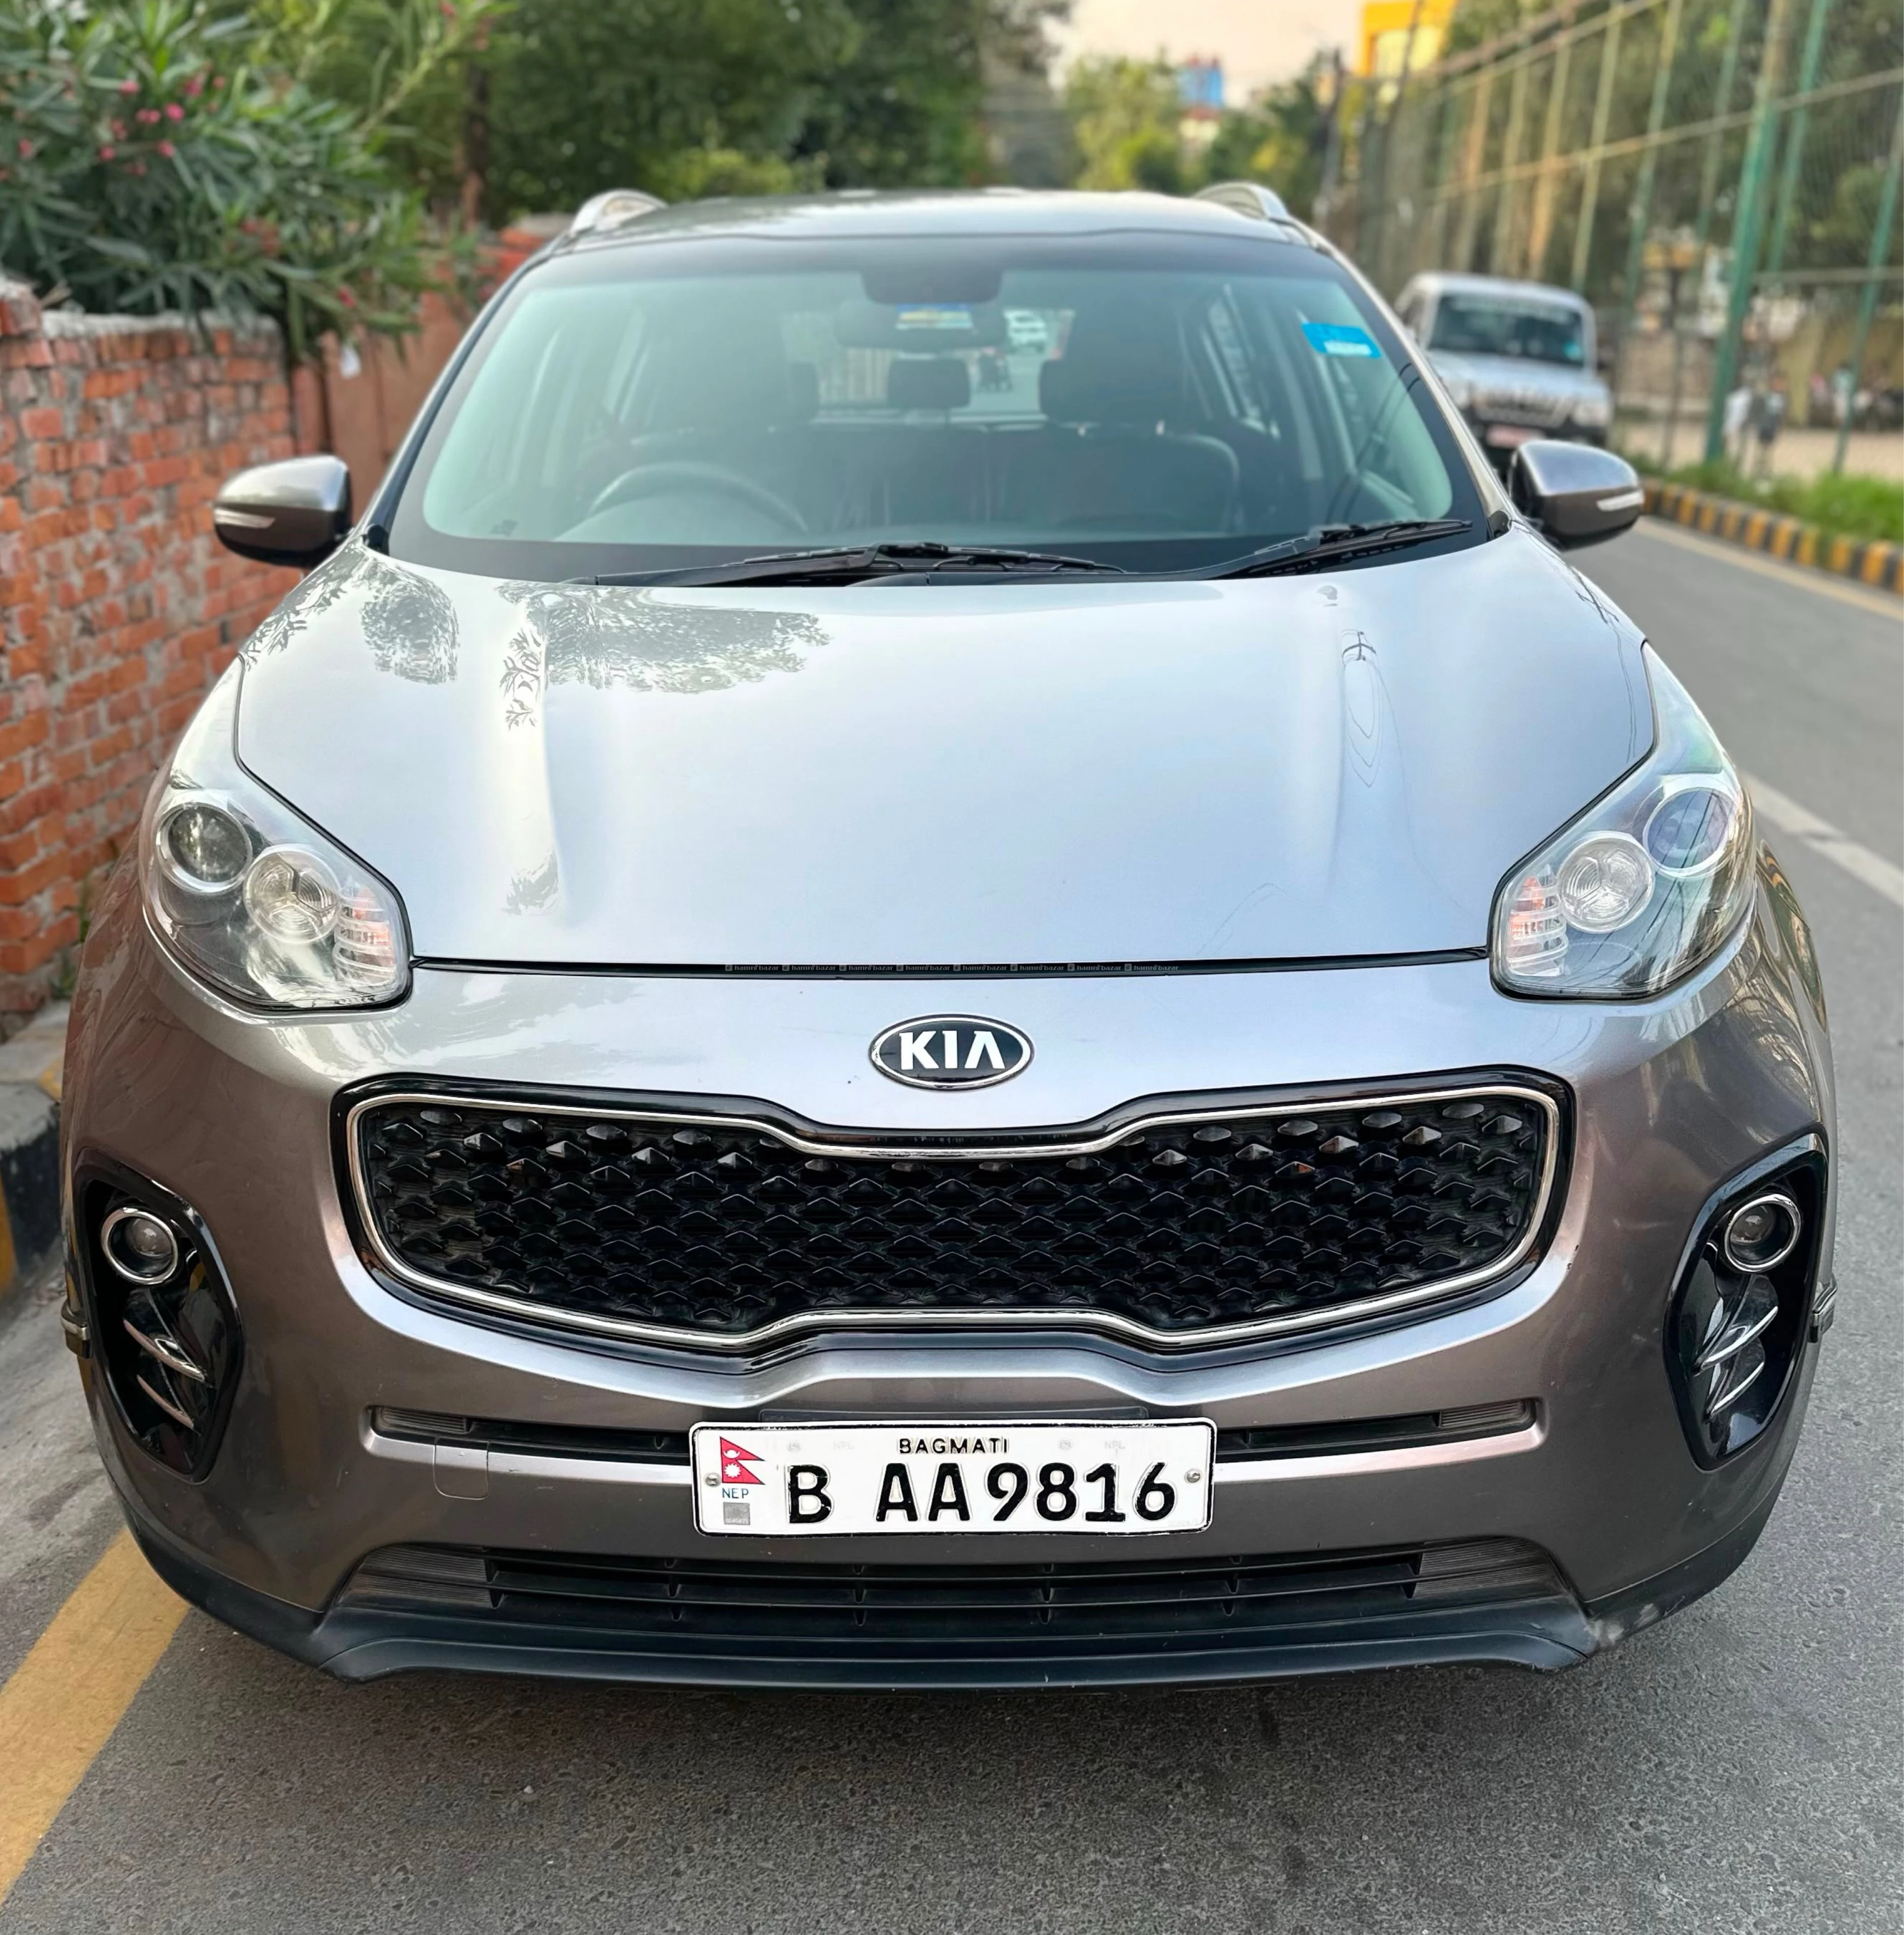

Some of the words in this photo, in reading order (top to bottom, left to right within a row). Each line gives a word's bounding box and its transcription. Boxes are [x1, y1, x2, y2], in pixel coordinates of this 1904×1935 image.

[899, 1030, 1005, 1070] KIA
[900, 1438, 1006, 1453] BAGMATI
[1104, 1440, 1126, 1449] NPL
[722, 1488, 749, 1499] NEP
[788, 1465, 831, 1523] B
